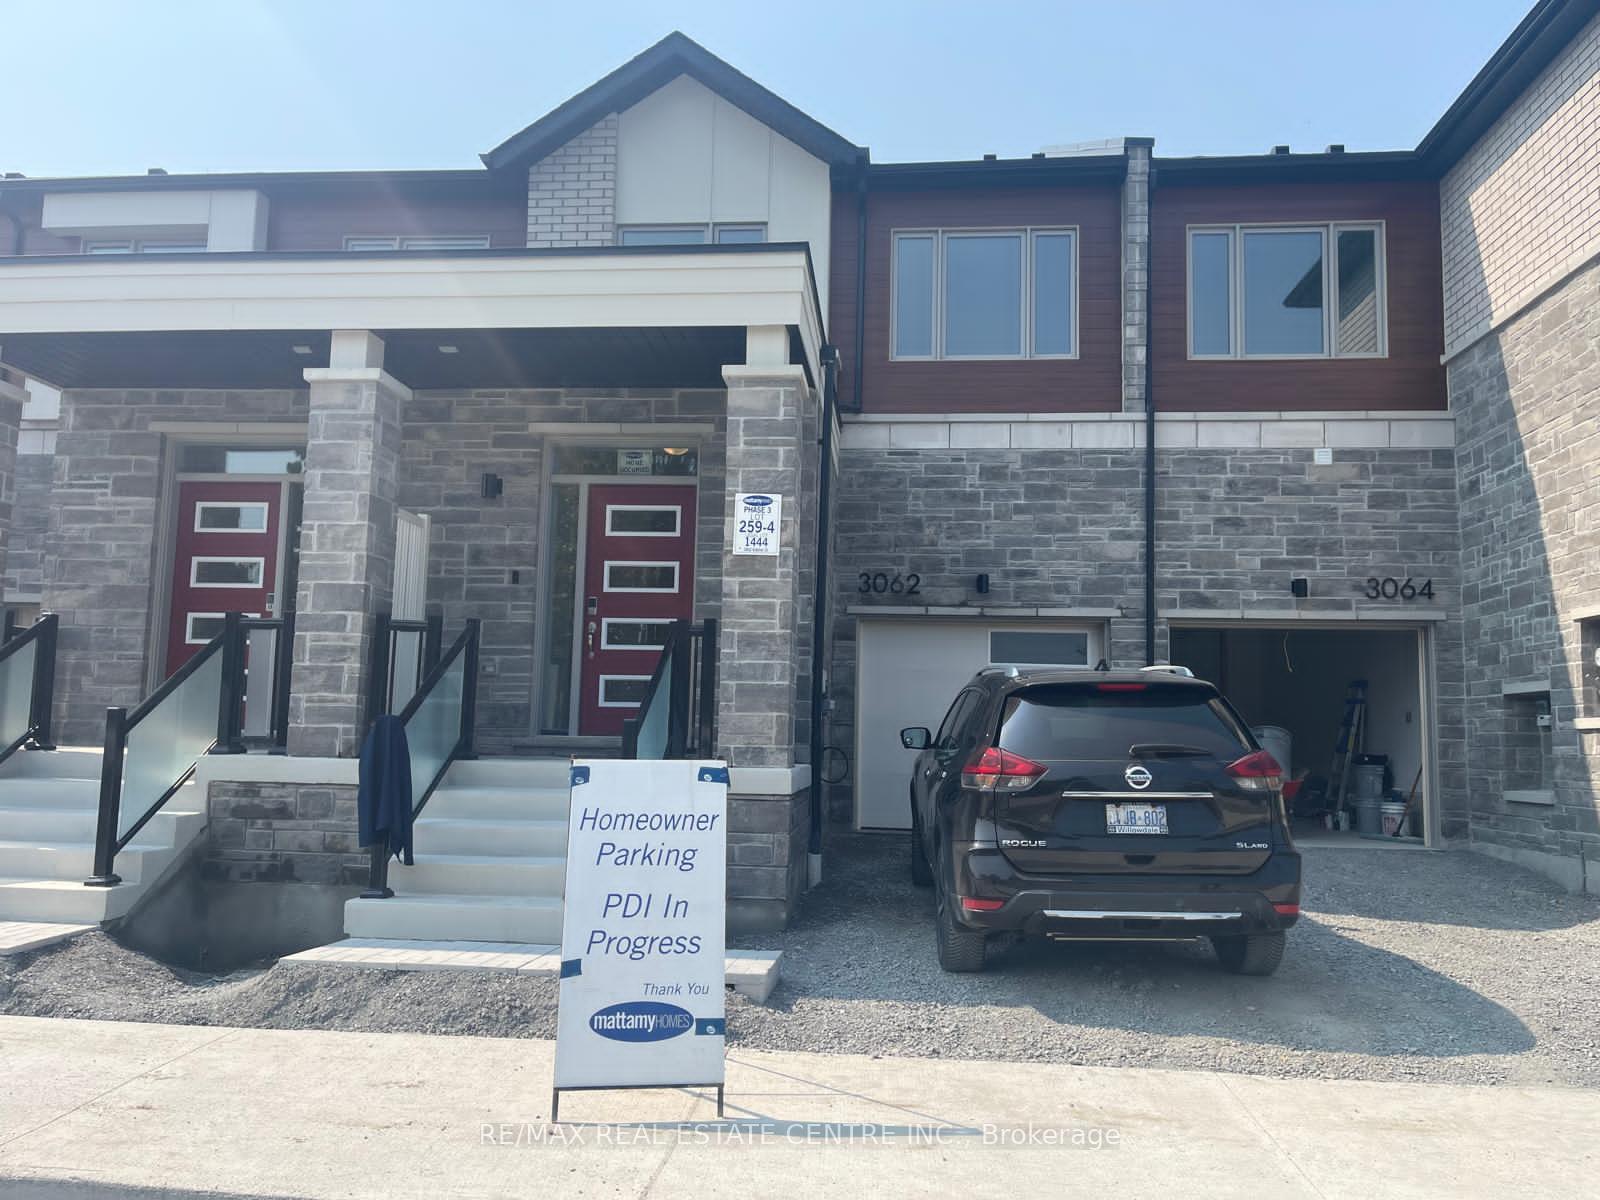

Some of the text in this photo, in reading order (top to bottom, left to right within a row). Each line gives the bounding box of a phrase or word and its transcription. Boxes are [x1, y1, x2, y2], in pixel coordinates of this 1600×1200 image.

[739, 520, 775, 533] 259-4
[745, 536, 769, 546] 1444
[858, 572, 921, 594] 3062
[1366, 577, 1436, 599] 3064
[579, 807, 720, 831] Homeowner
[1117, 825, 1160, 833] Willowdale
[1001, 839, 1047, 847] ROGUE
[595, 842, 698, 872] Parking
[602, 893, 689, 918] PDI In
[586, 930, 702, 960] Progress
[643, 982, 710, 996] Thank You
